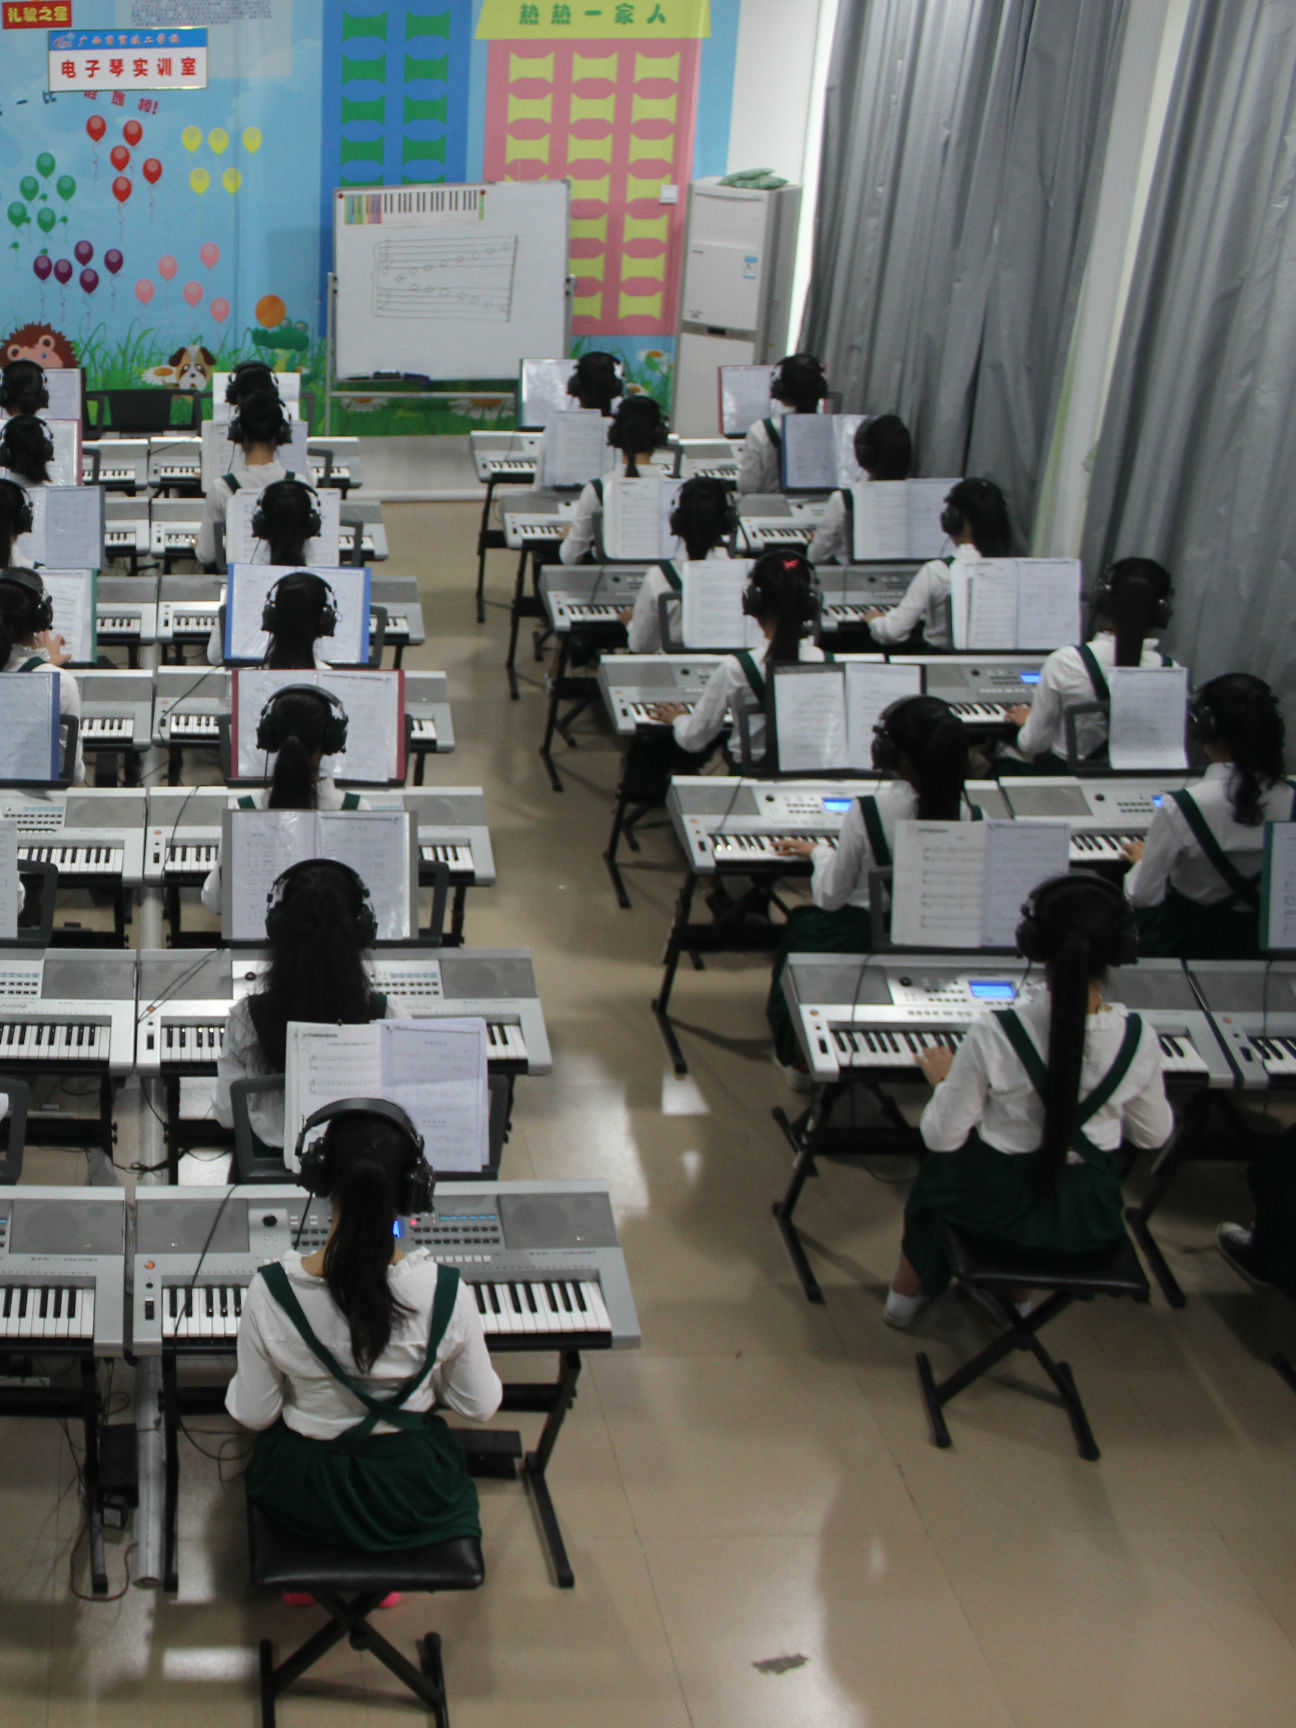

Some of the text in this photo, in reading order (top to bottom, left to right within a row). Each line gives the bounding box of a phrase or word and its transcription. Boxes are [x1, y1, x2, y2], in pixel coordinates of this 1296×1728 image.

[7, 6, 68, 23] 礼貌之星
[61, 57, 196, 78] 电子琴实训室
